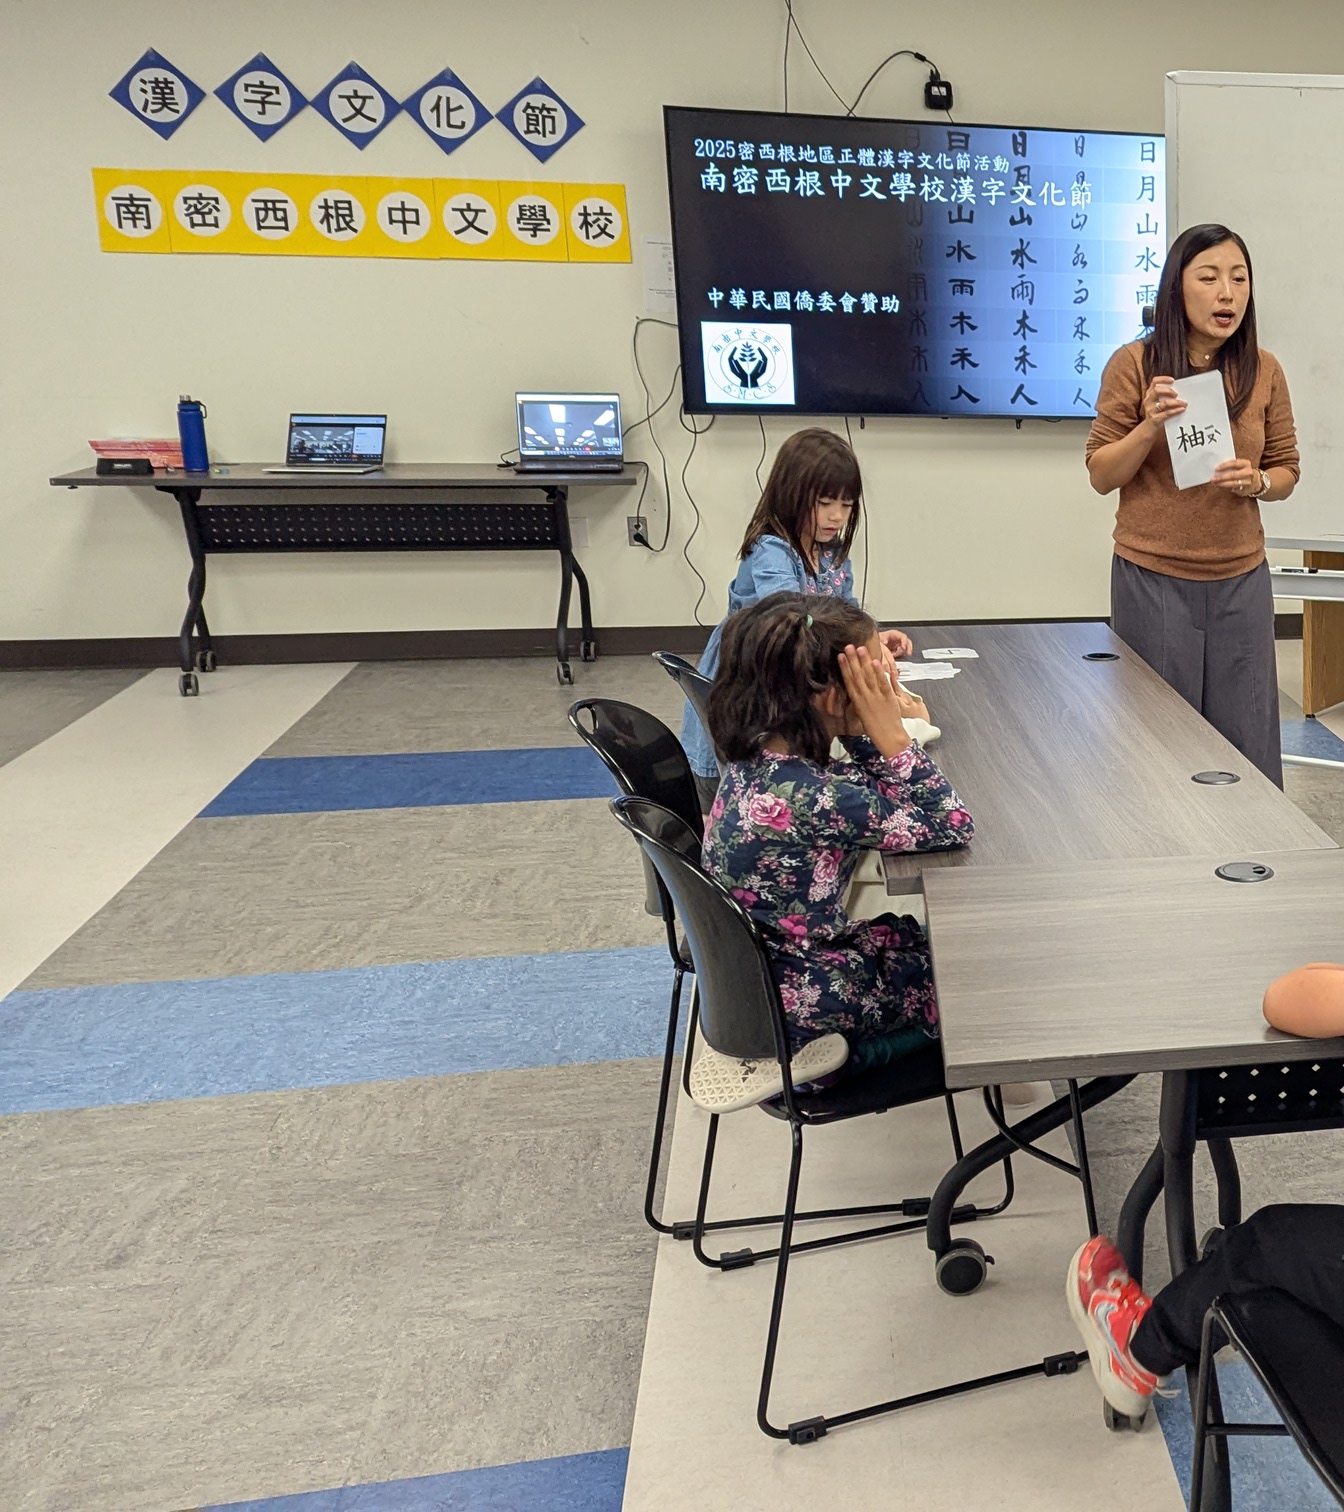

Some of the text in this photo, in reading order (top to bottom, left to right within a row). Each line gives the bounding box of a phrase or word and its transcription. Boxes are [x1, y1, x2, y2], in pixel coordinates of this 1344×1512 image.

[139, 77, 558, 139] 漢字文化節
[694, 138, 1010, 174] 2025密西根地區正體漢字文化節活動
[700, 161, 1092, 210] 南密西根中文學校漢字文化節
[111, 192, 617, 242] 南密西根中文學校
[707, 286, 900, 314] 中華民國僑委會贊助
